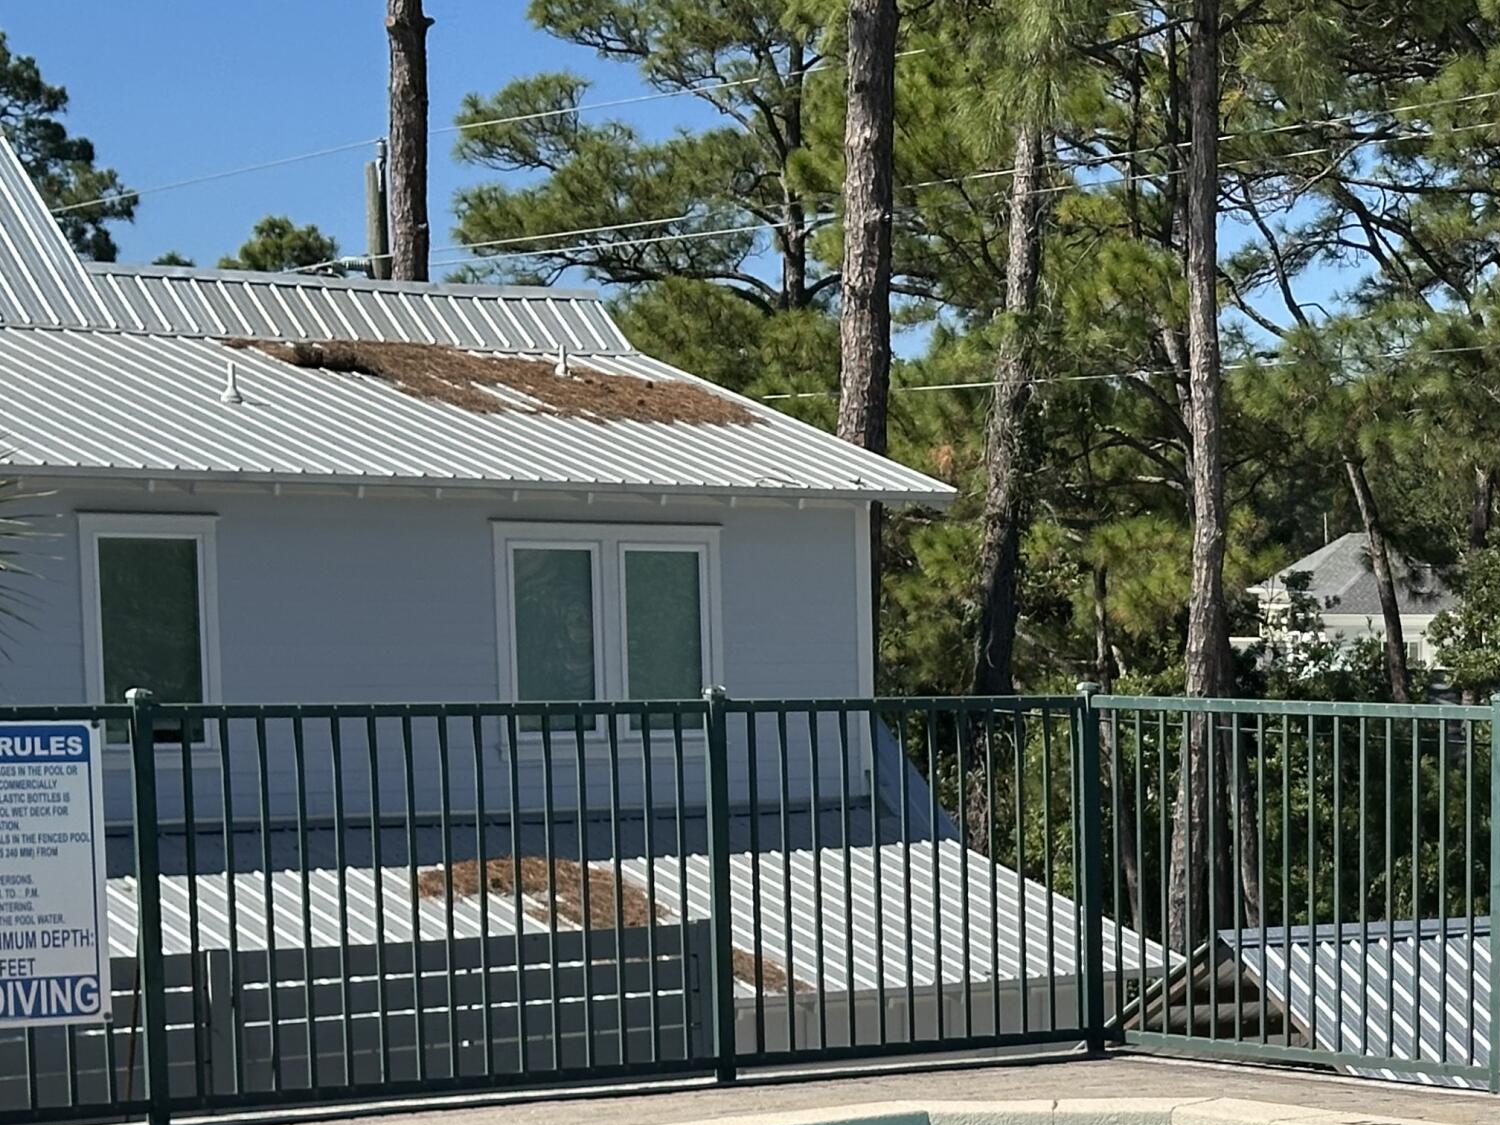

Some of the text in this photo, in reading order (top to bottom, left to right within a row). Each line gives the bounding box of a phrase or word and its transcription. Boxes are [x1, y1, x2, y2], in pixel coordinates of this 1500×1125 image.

[28, 765, 43, 776] THE
[44, 765, 64, 776] POOL
[66, 764, 78, 775] OR
[27, 793, 61, 804] BOTTLES
[12, 806, 28, 817] WET
[30, 806, 51, 817] DECK
[53, 805, 69, 816] FOR
[22, 833, 36, 844] THE
[38, 833, 69, 844] FENCED
[70, 832, 90, 843] POOL
[36, 846, 59, 857] FROM
[5, 888, 16, 899] TO
[15, 914, 35, 926] POOL
[41, 928, 94, 949] DEPTH:
[0, 977, 100, 1017] IVING
